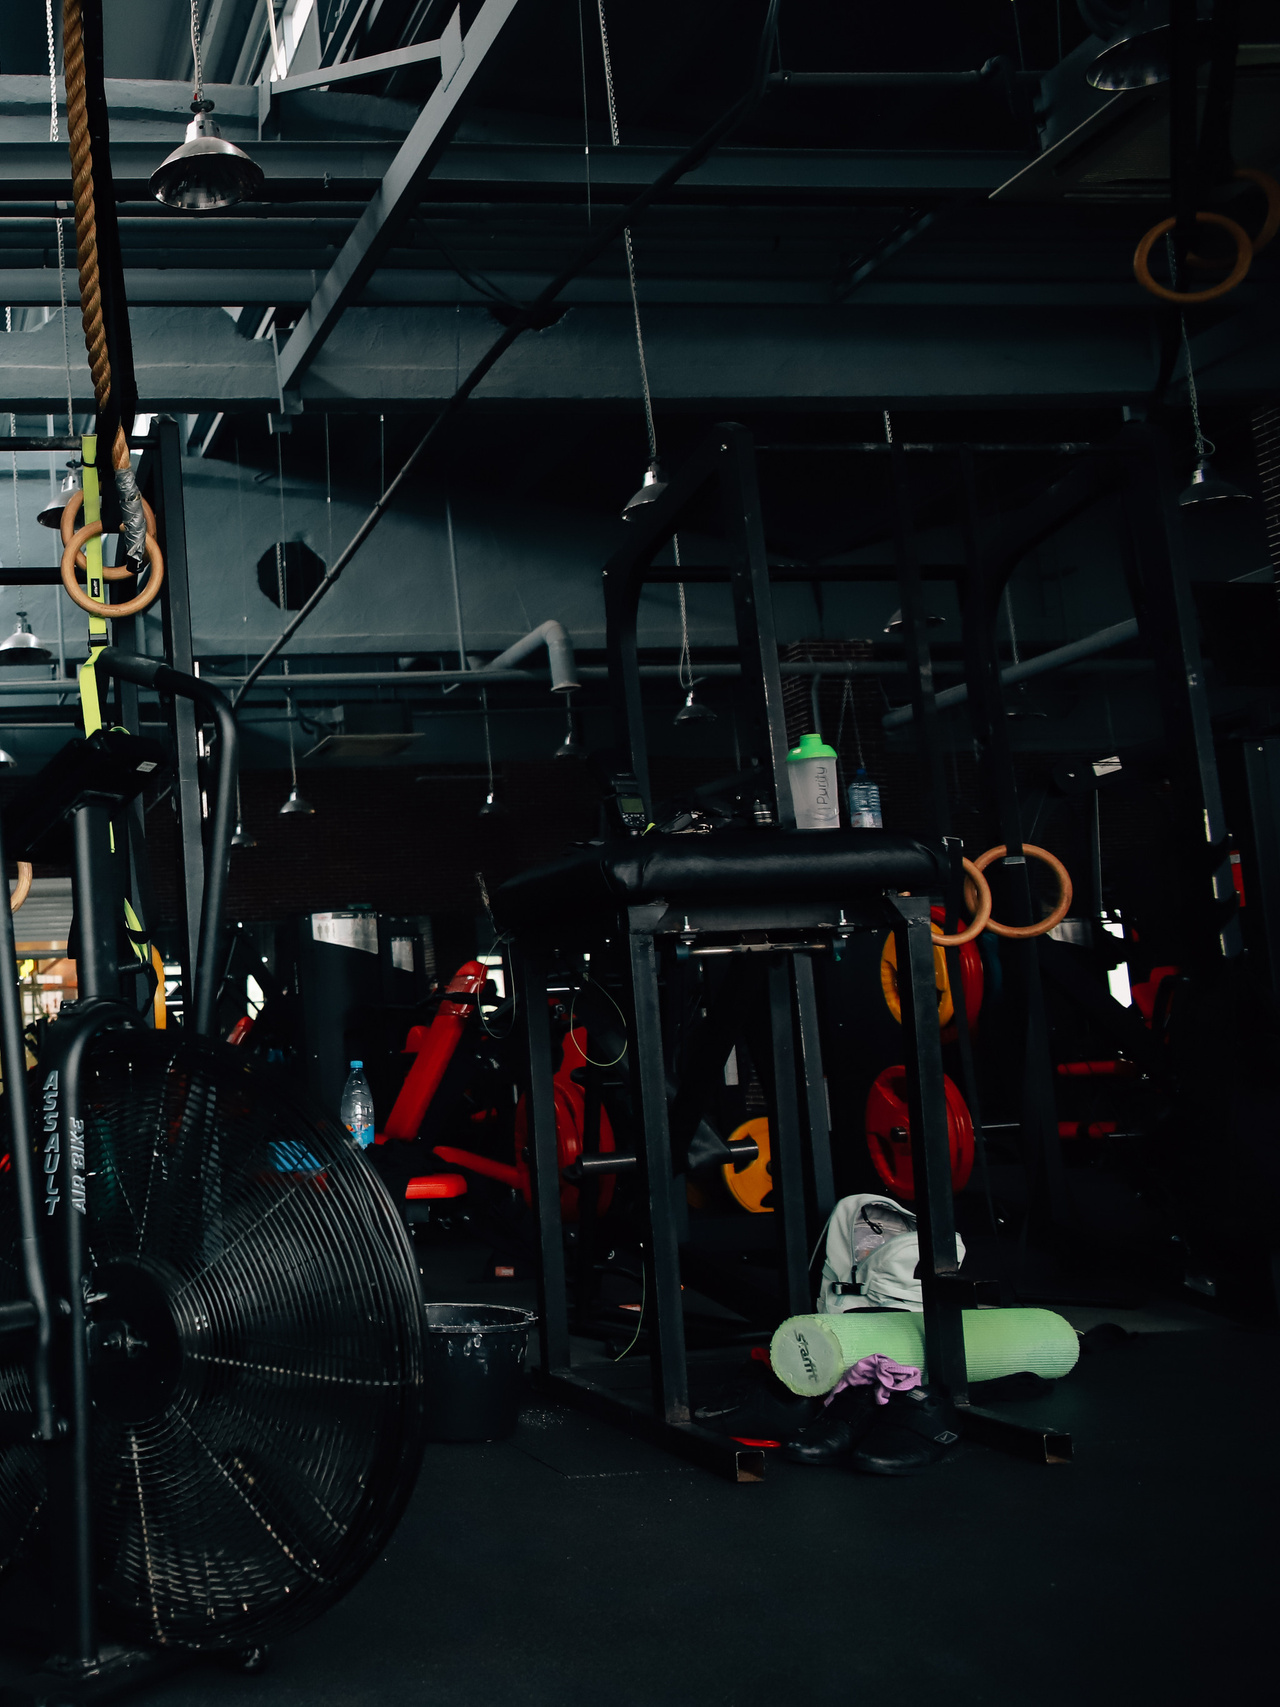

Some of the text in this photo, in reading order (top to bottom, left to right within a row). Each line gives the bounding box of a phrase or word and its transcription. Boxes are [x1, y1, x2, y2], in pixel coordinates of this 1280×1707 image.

[42, 1070, 61, 1216] ASSAULT
[69, 1116, 87, 1215] AIR BIKE
